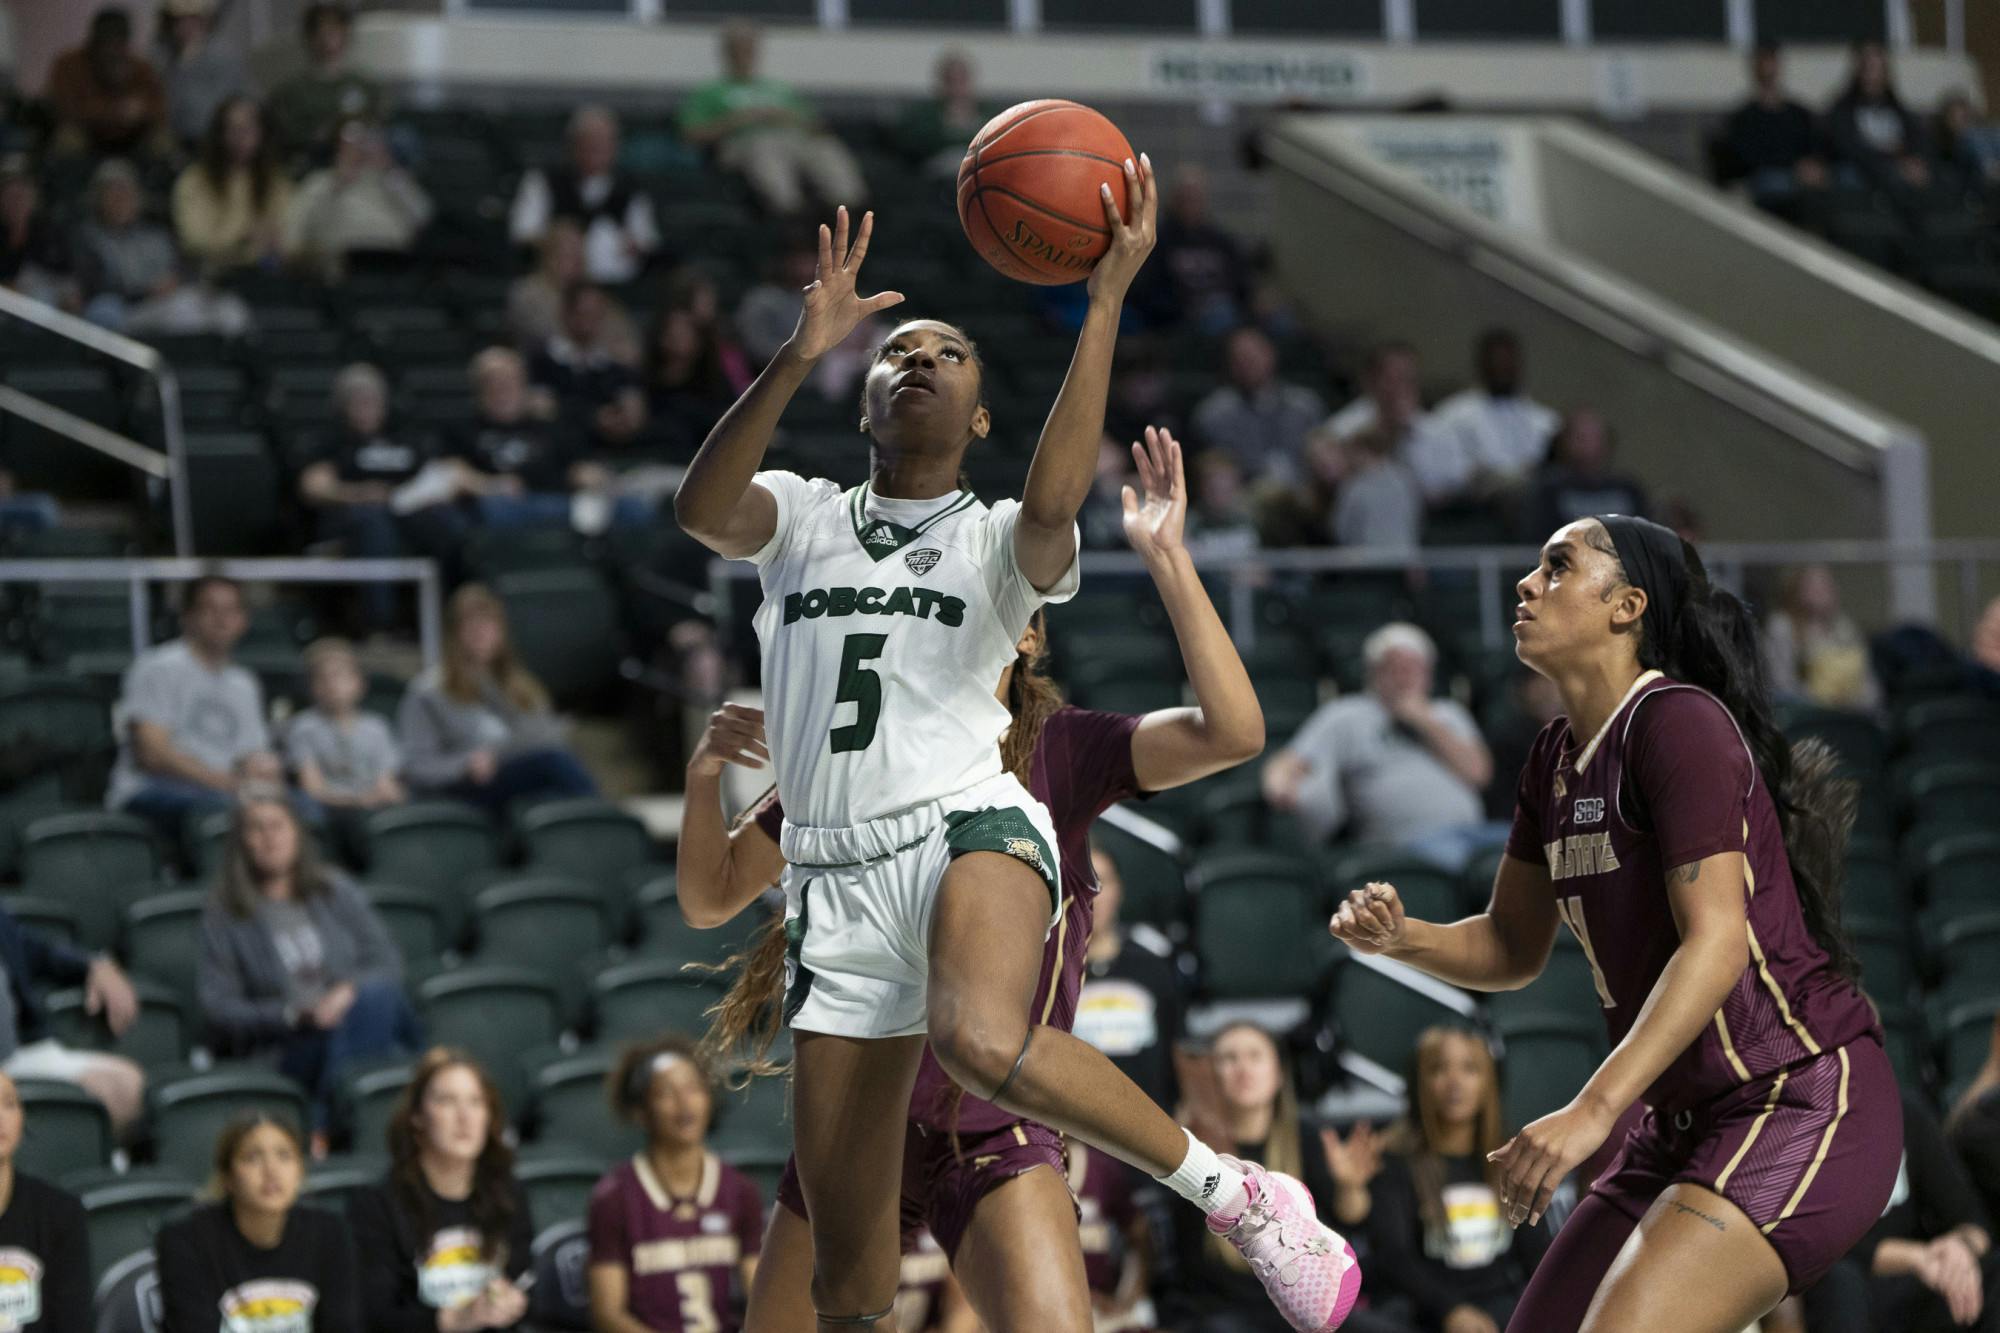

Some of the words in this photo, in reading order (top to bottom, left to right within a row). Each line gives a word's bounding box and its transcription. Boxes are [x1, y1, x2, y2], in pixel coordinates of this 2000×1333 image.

[865, 535, 898, 547] adidas
[784, 587, 966, 628] BOBCATS
[829, 633, 889, 755] 5
[1574, 798, 1605, 824] SBC
[1201, 1172, 1221, 1199] adidas
